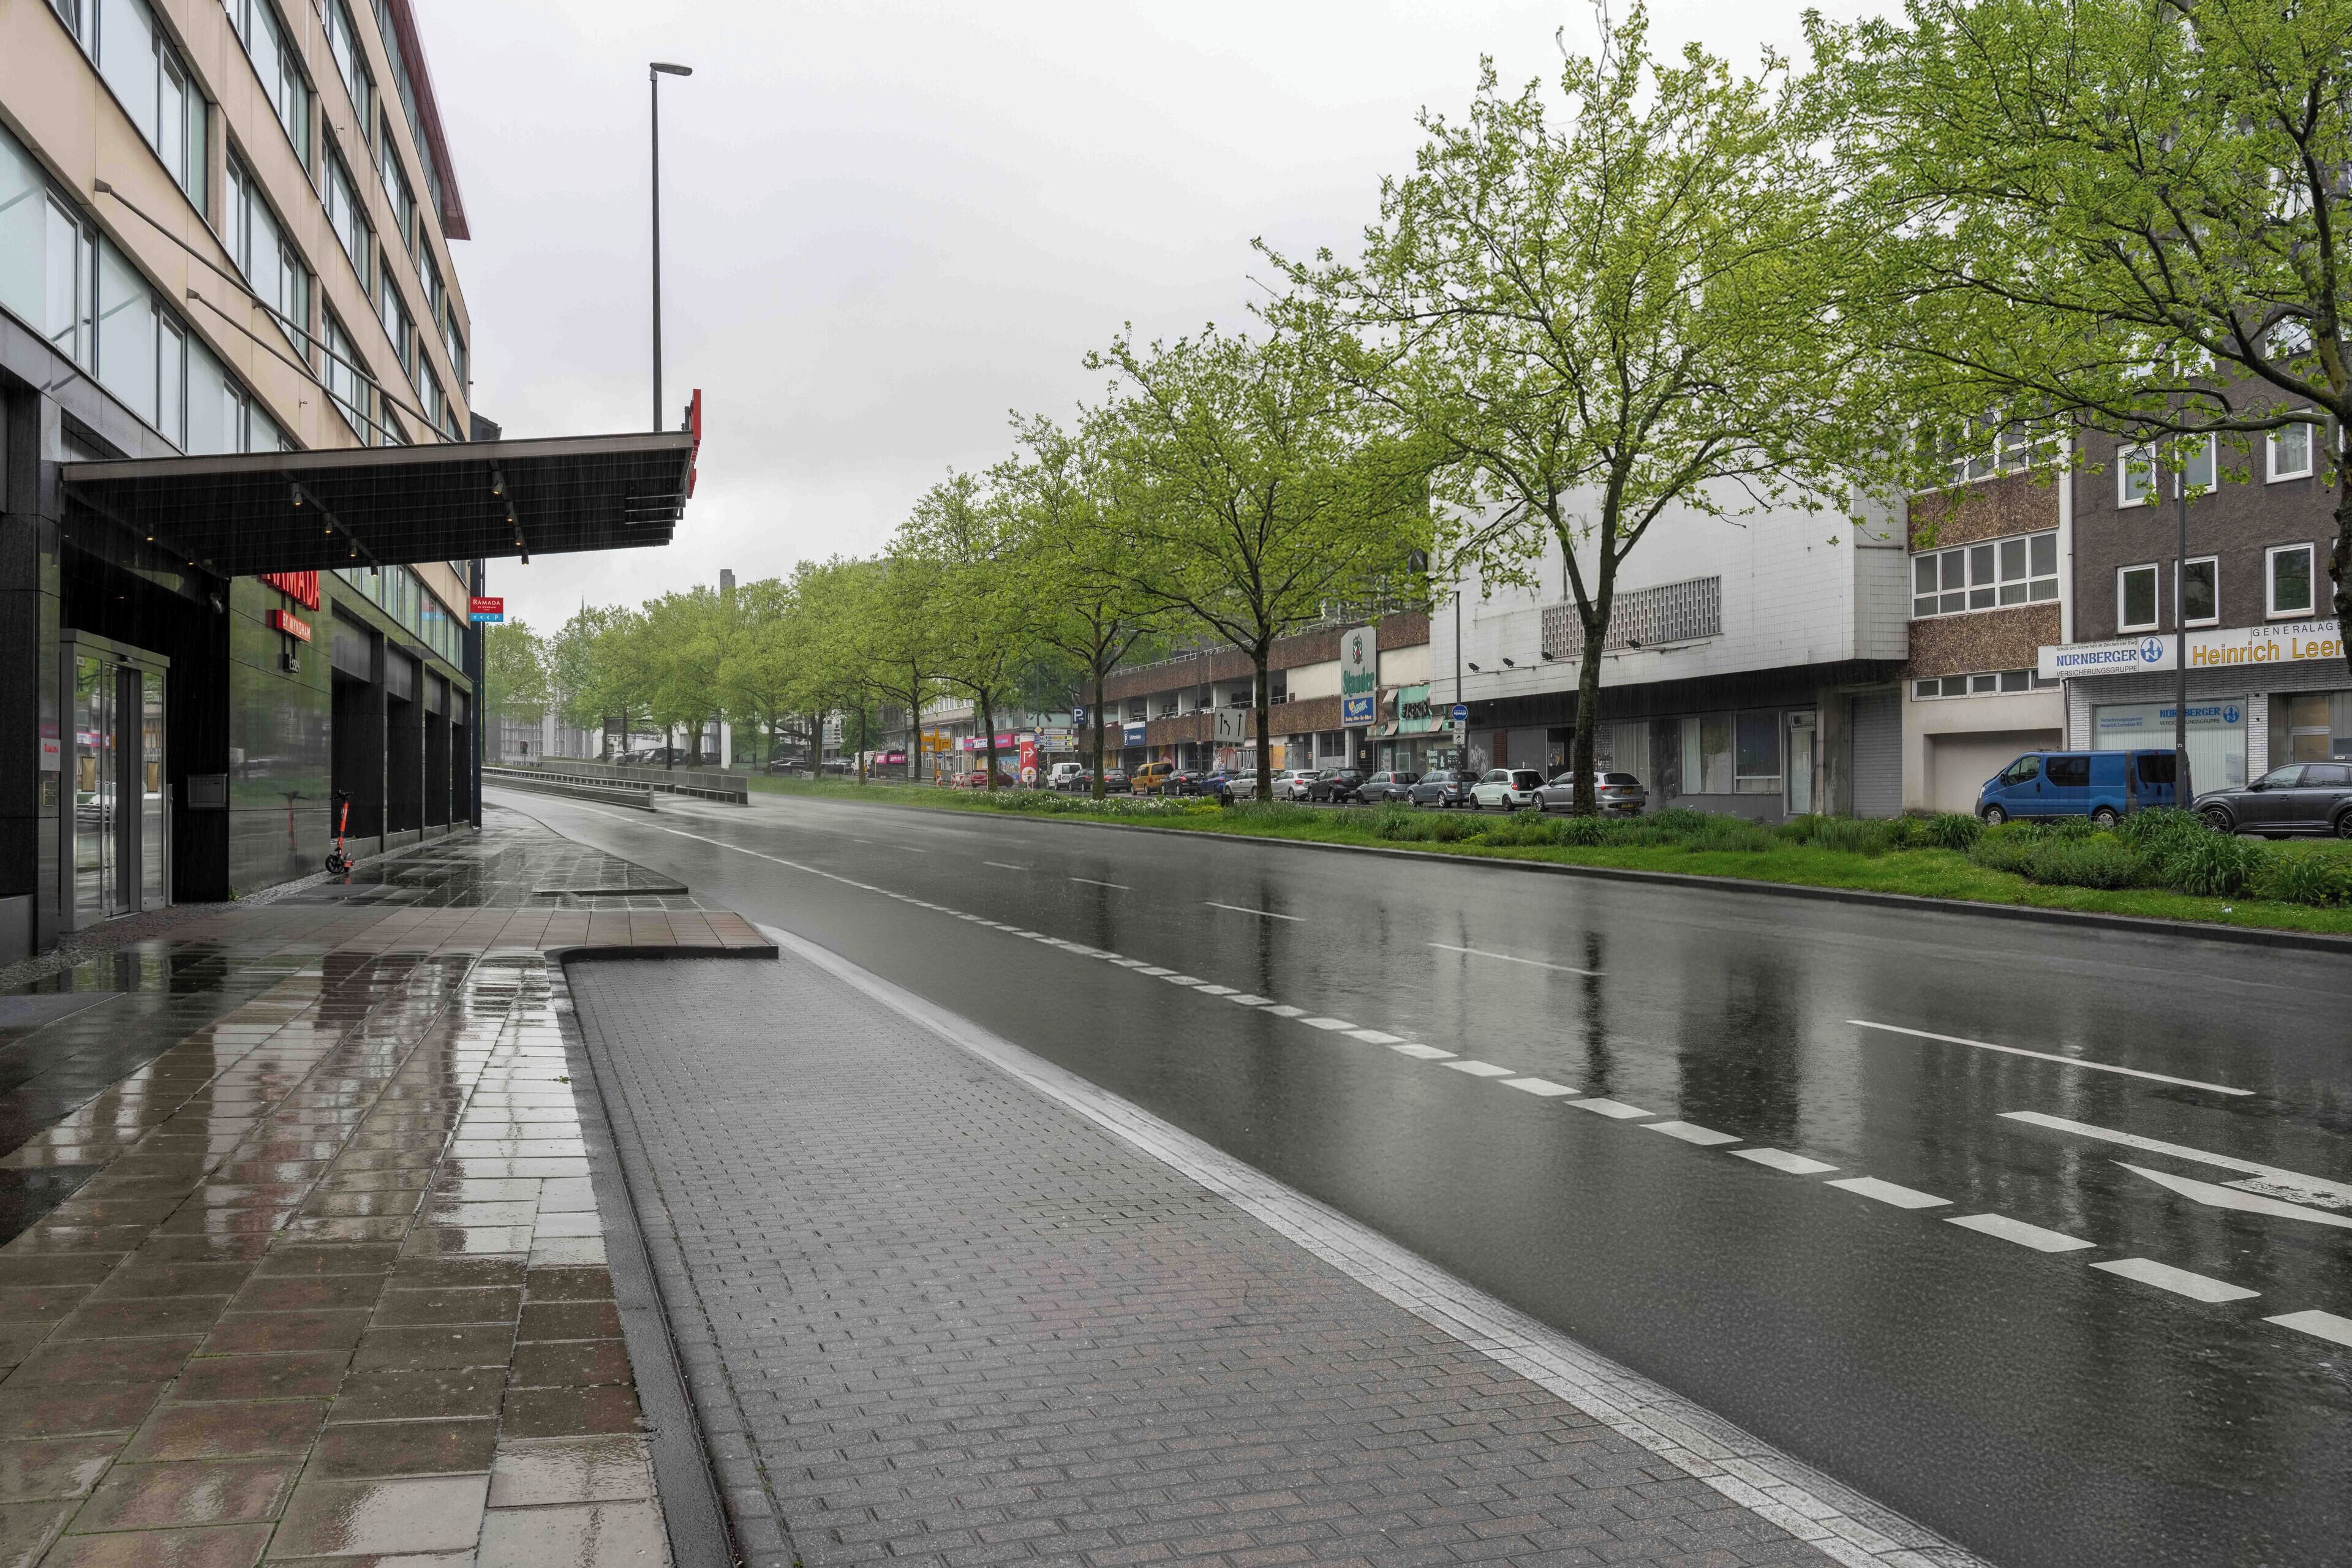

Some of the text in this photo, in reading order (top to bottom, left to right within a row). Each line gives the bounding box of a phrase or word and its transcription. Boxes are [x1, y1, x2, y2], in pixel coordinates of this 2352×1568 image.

[266, 570, 320, 611] MADA
[283, 612, 311, 640] BY WYNDHAM
[2056, 649, 2137, 667] NÜRNBERGER
[2193, 639, 2280, 666] Heinrich
[1343, 666, 1374, 697] Stauder
[2056, 665, 2137, 677] VERSICHERUNGSGRUPPE
[1074, 709, 1084, 722] P
[2160, 707, 2220, 718] NÜRBERGER
